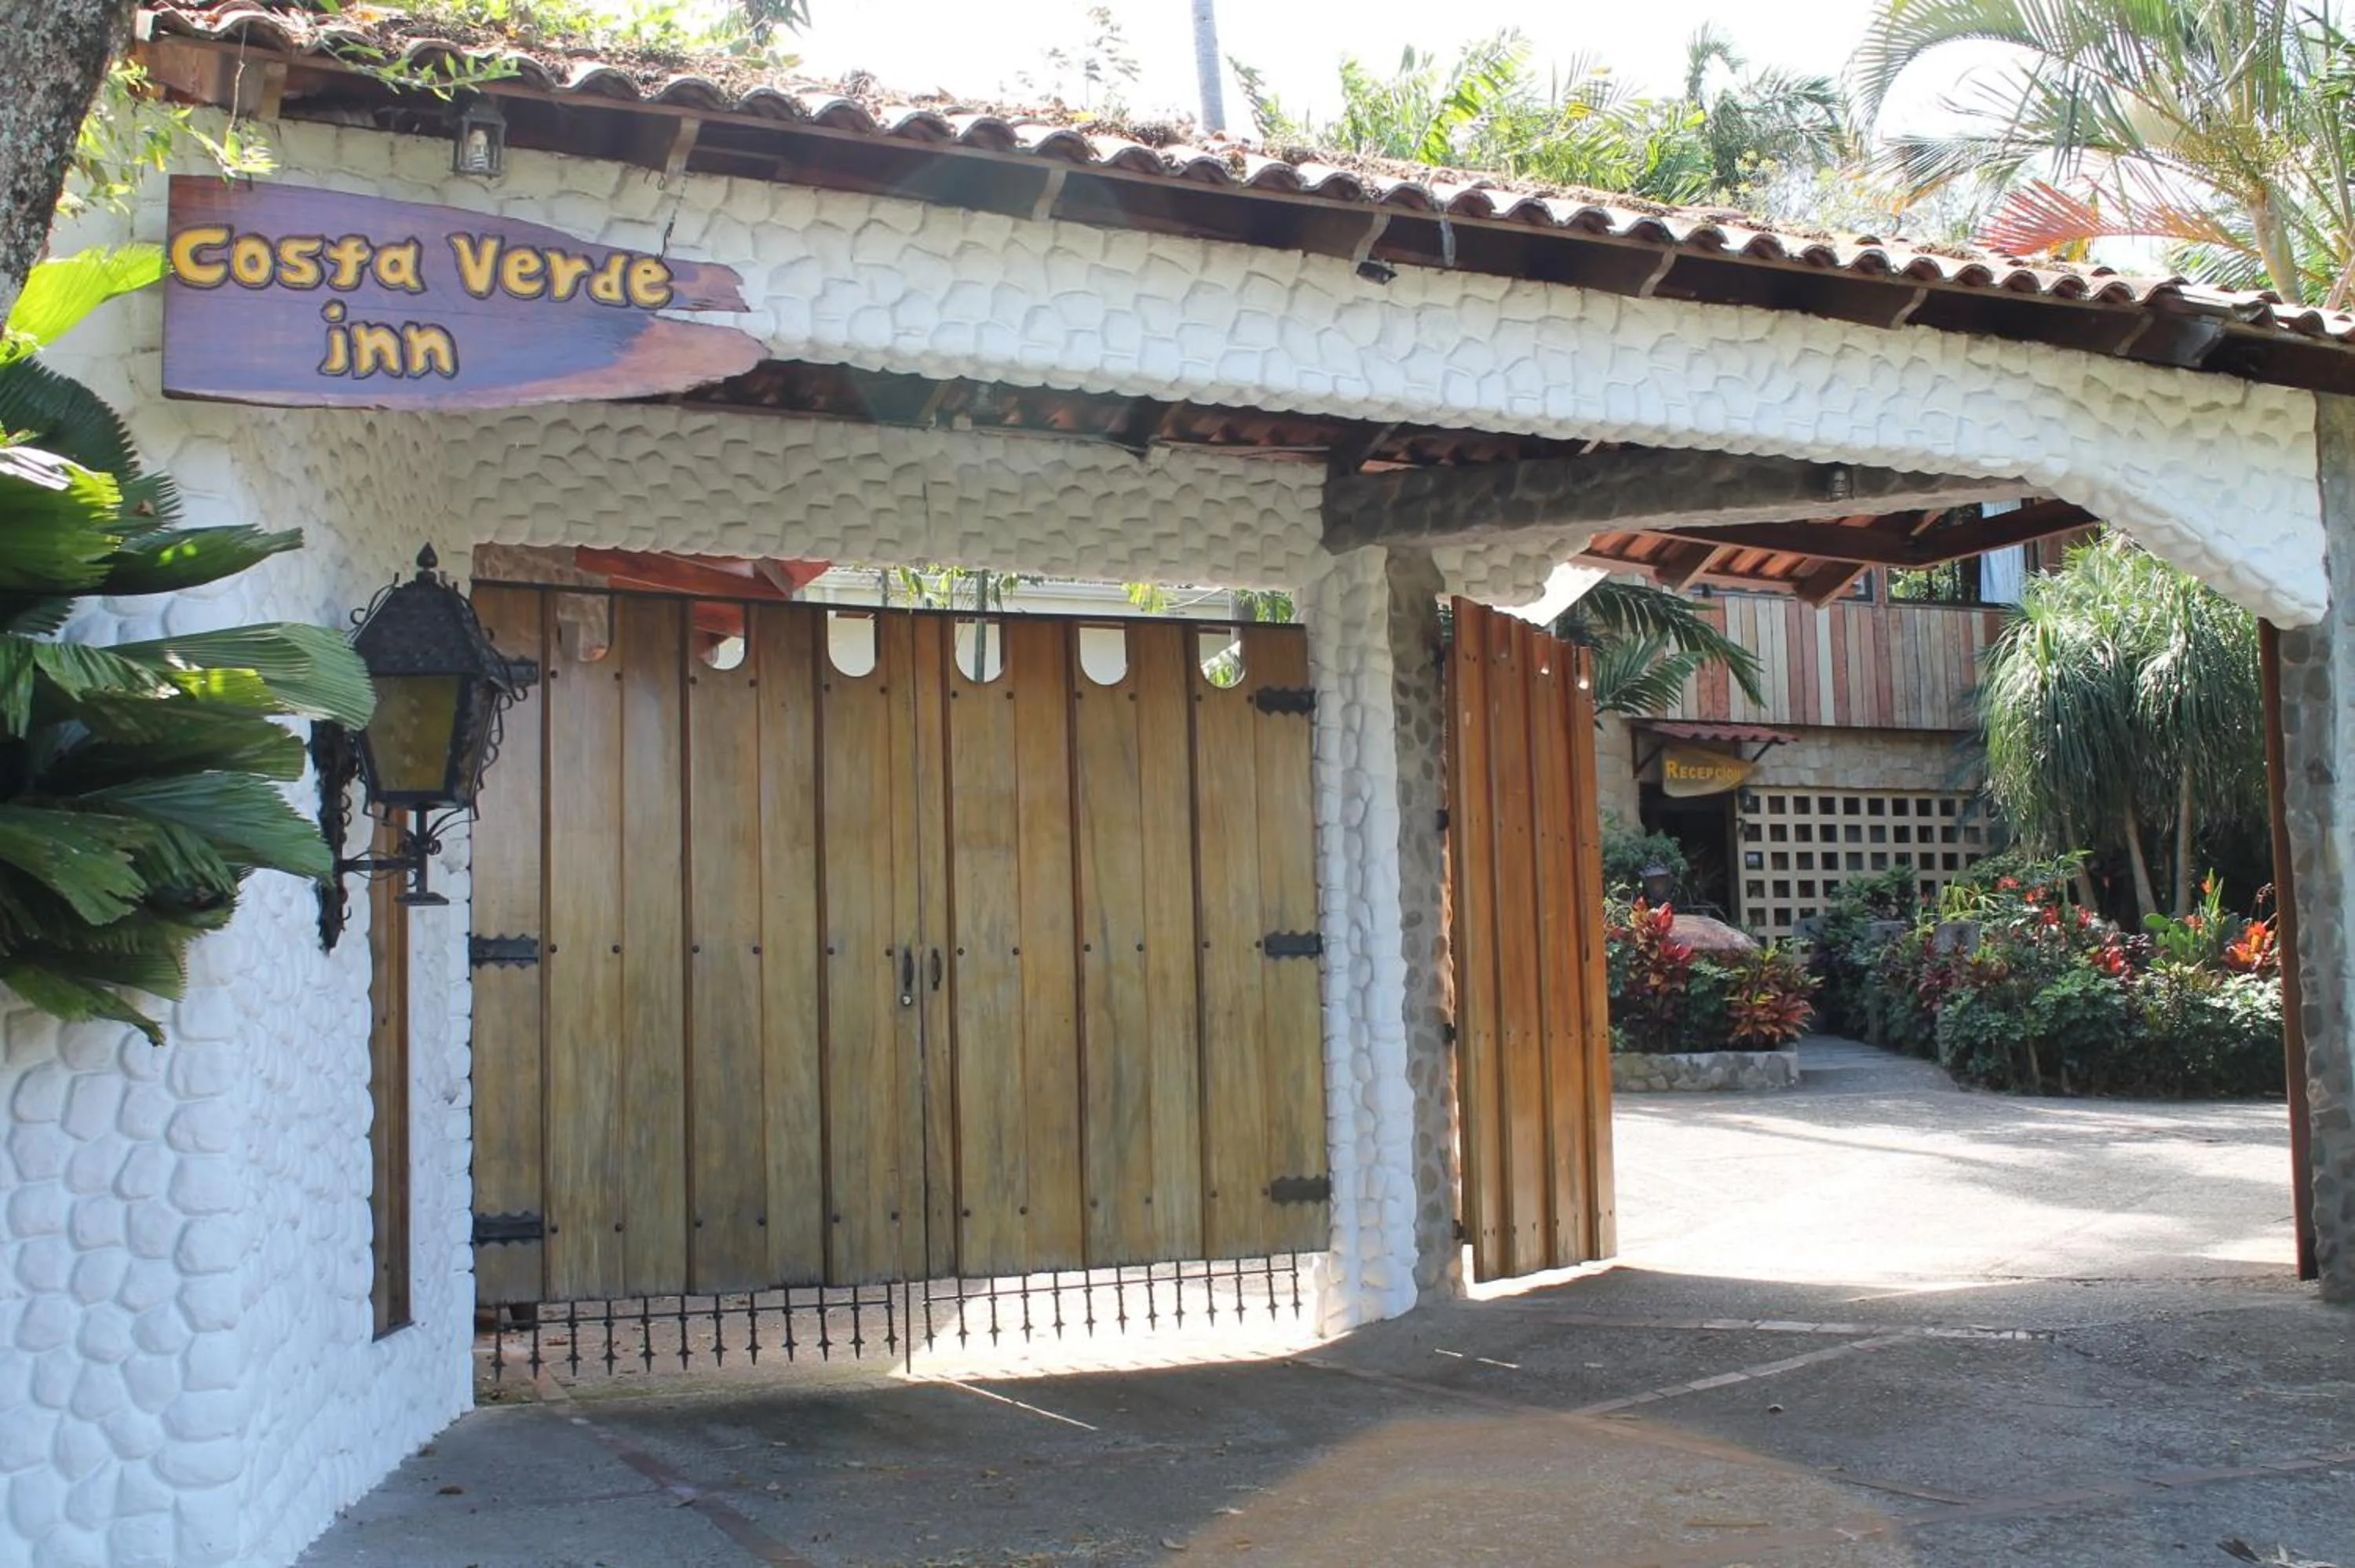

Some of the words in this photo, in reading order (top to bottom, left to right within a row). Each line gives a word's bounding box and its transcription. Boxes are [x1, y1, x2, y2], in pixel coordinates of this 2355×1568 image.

[170, 226, 426, 294] Costa
[447, 233, 673, 308] Verde
[318, 299, 459, 378] inn
